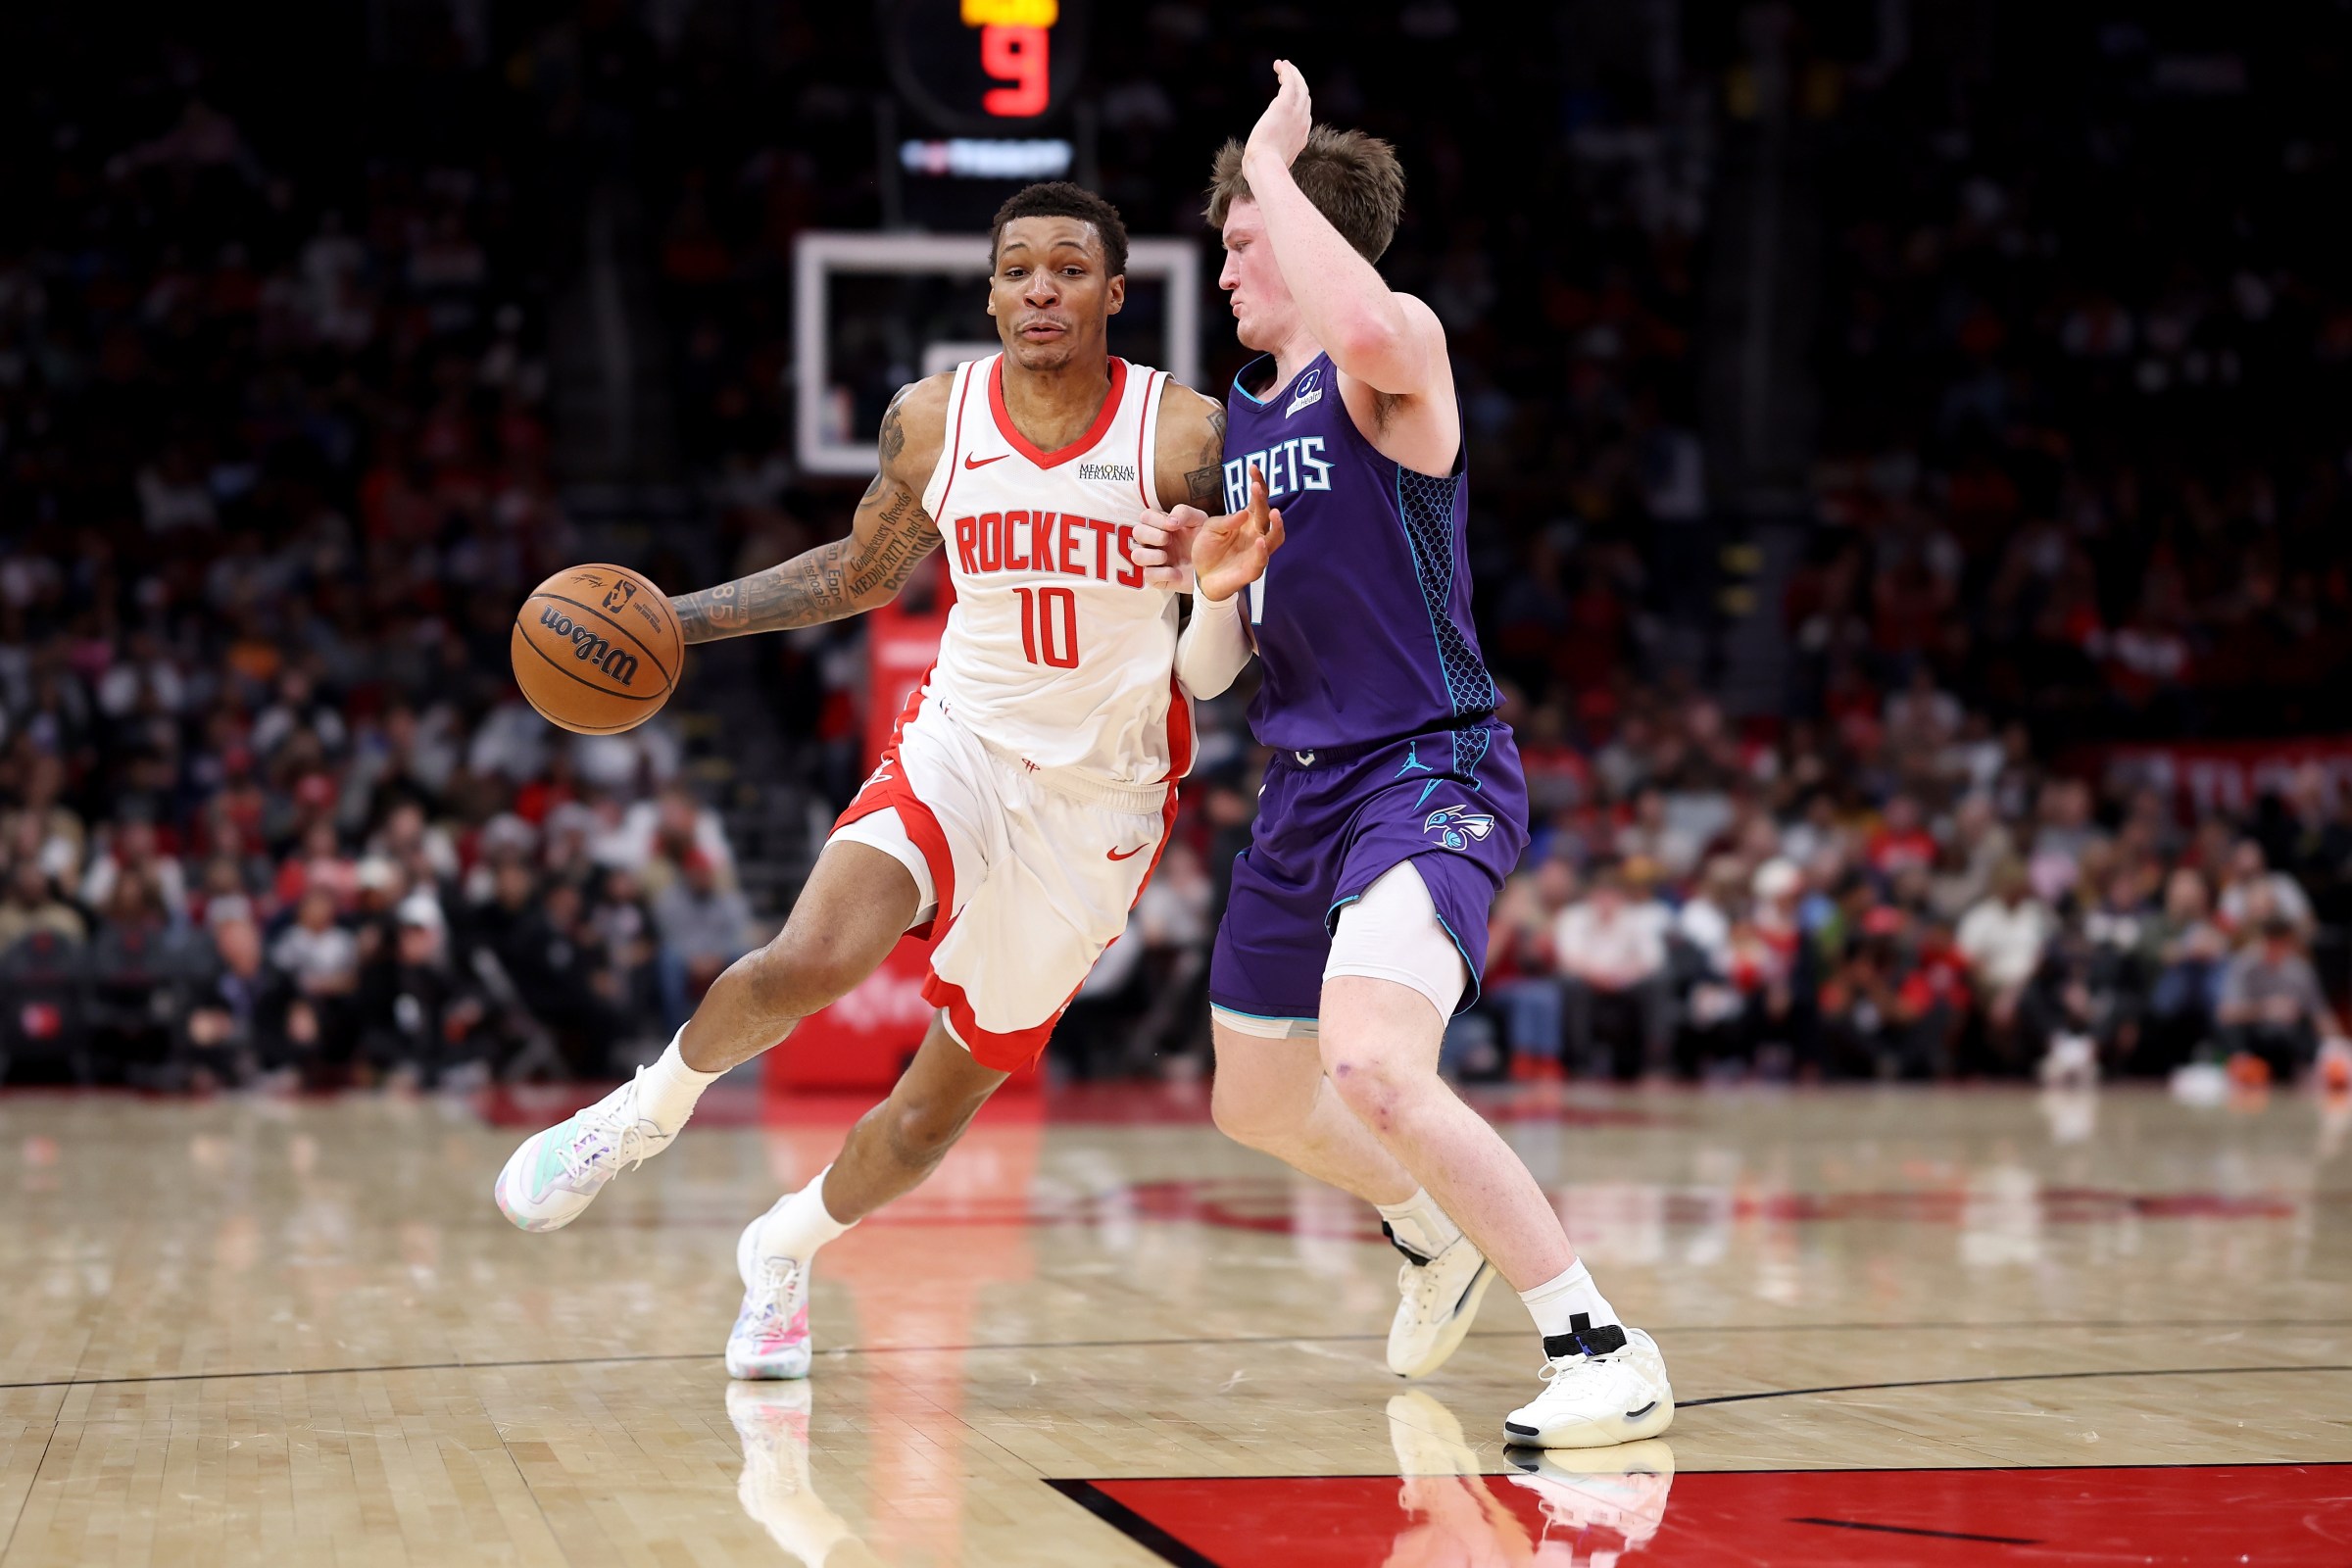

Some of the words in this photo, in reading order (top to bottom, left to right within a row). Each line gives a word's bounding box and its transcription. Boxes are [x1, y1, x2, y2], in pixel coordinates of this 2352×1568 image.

[981, 23, 1050, 117] 9
[878, 492, 912, 525] Breeds
[1079, 464, 1135, 474] MEMORIAL
[1079, 470, 1135, 481] HERMANN
[1222, 436, 1336, 514] RNETS
[849, 534, 908, 599] MEDIOCRITY
[899, 517, 921, 543] And
[955, 510, 1145, 590] ROCKETS
[540, 605, 638, 686] Wilson
[1011, 587, 1079, 668] 10
